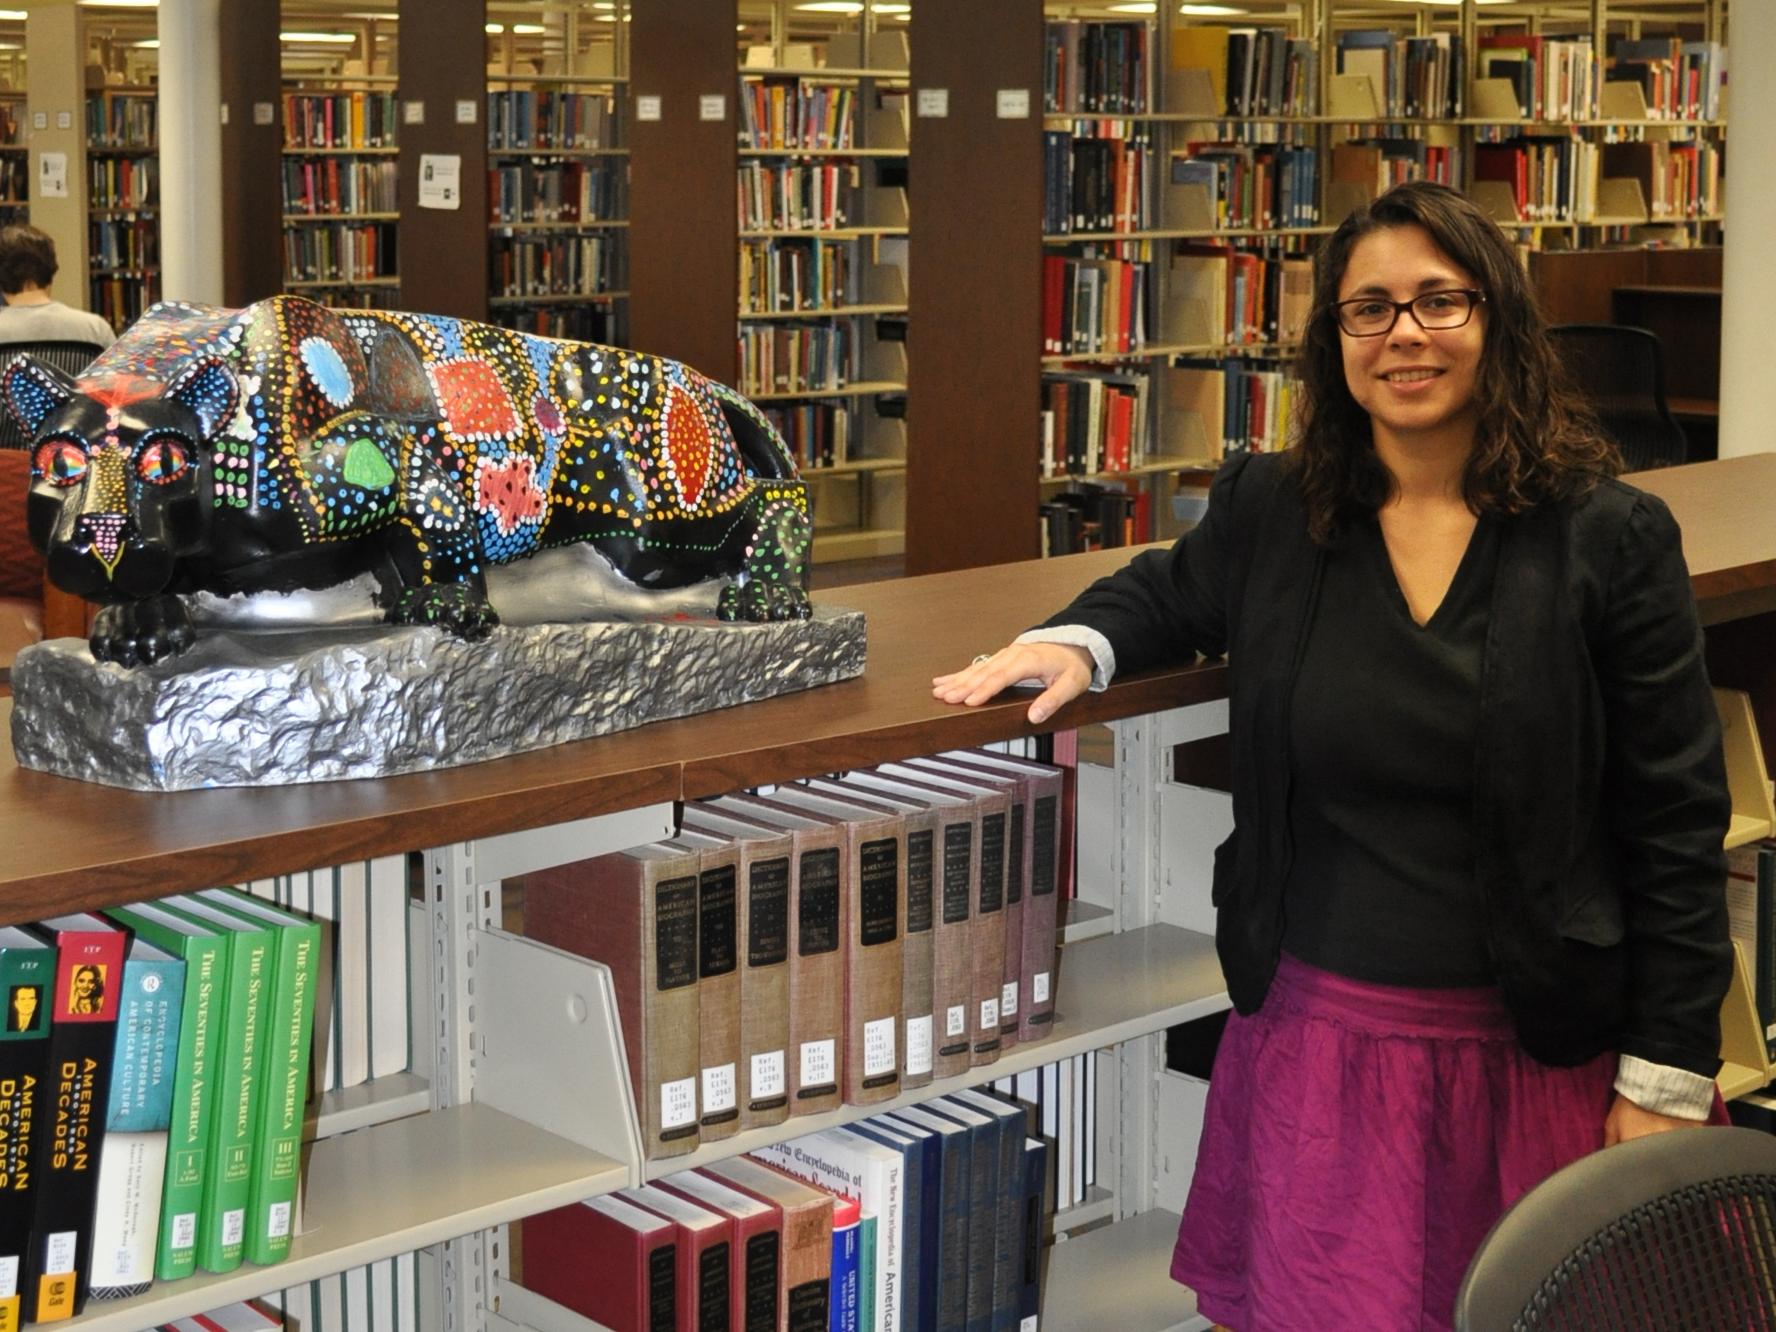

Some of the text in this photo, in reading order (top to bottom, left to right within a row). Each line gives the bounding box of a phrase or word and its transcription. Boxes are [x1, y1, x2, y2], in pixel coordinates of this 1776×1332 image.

[120, 1001, 139, 1116] AMERICAN CULTURE
[136, 1001, 153, 1109] OF CONTEMPORARY
[152, 1001, 168, 1086] ENCYCLOPEDIA
[188, 950, 215, 1144] THE SEVENTIES IN AMERICA
[237, 946, 264, 1139] THE SEVENTIES IN AMERICA
[283, 940, 310, 1131] THE SEVENTIES IN AMERICA
[15, 1074, 37, 1190] AMERICAN
[53, 1062, 77, 1169] DECADES
[73, 1058, 97, 1171] AMERICAN
[794, 1147, 850, 1182] Encyclopedia
[853, 1174, 862, 1188] of
[847, 1269, 857, 1308] UNITED
[884, 1272, 897, 1332] American
